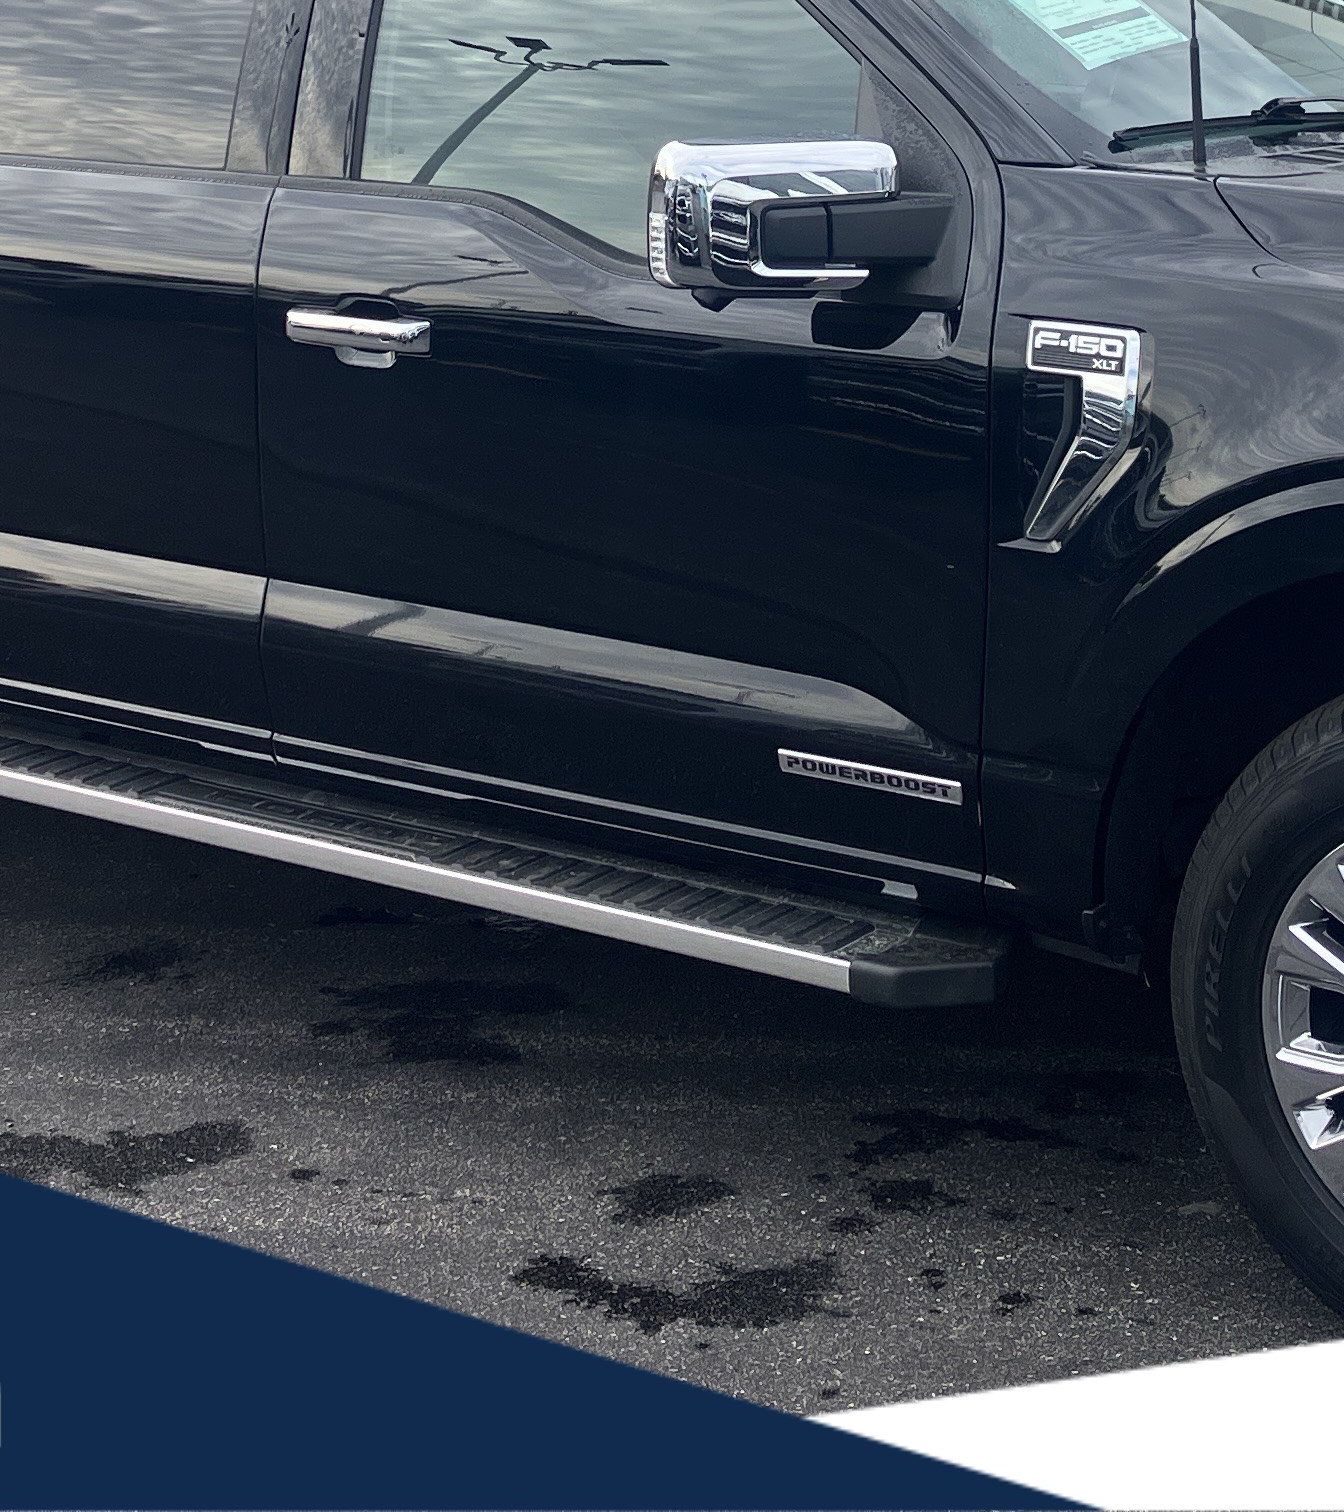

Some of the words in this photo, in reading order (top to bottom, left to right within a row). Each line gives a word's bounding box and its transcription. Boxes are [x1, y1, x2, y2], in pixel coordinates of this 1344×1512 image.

[1033, 330, 1126, 358] F-150
[1091, 358, 1120, 372] XLT
[786, 755, 952, 798] POWERBOOST
